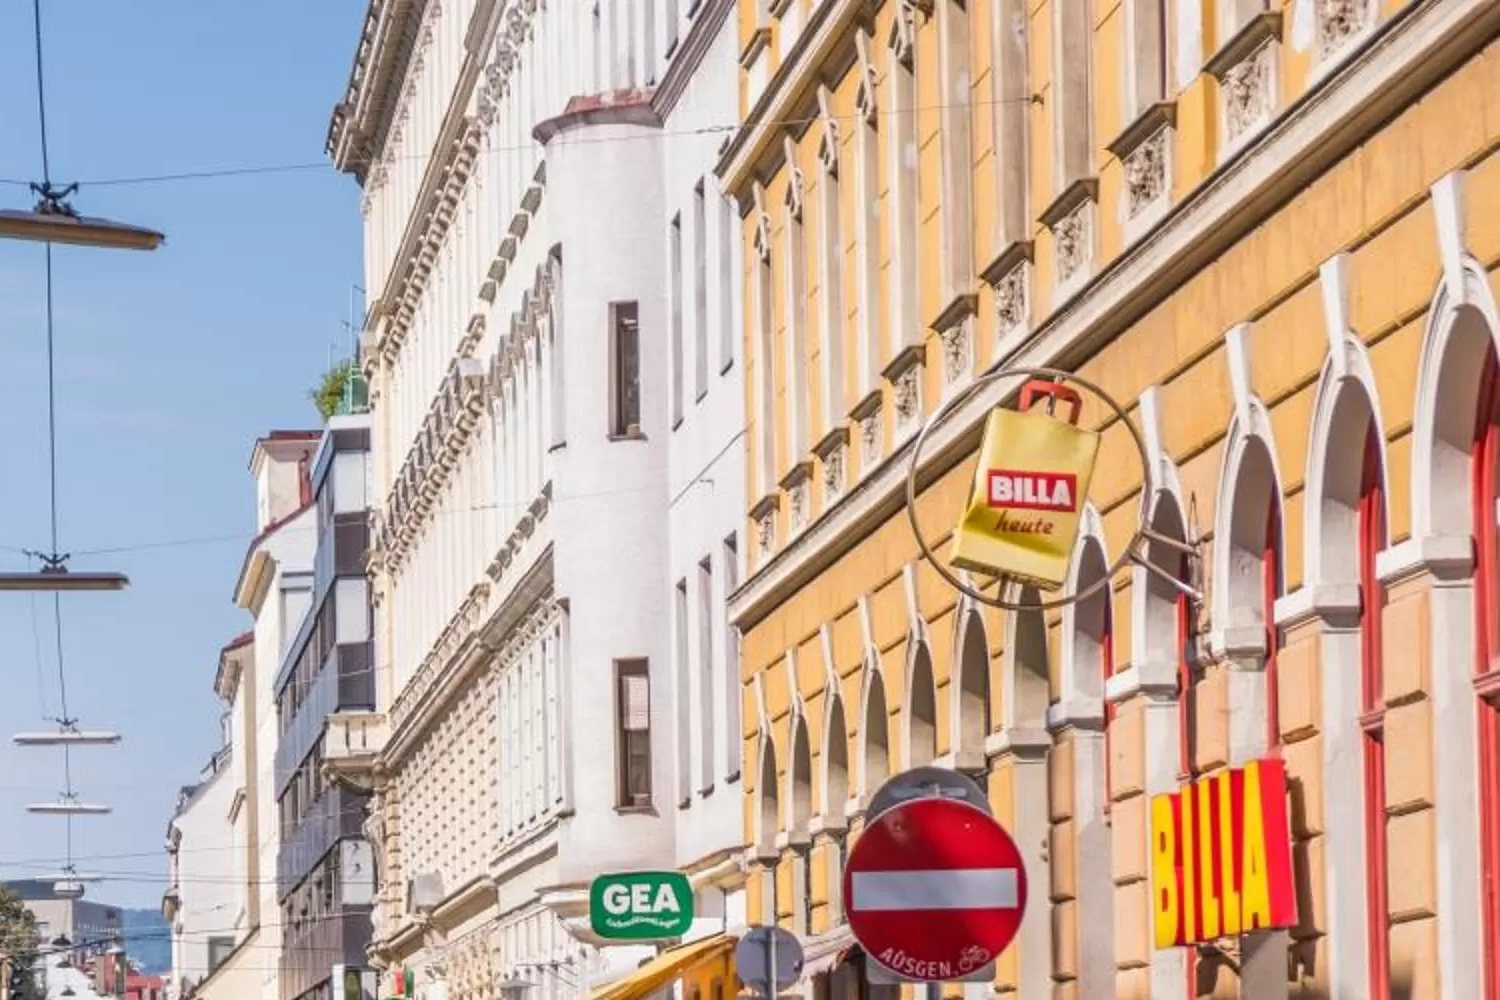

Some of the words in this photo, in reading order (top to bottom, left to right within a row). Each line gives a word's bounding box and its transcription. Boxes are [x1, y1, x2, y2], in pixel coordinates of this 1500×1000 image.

[991, 475, 1072, 506] BILLA
[994, 509, 1054, 535] heute
[1152, 759, 1271, 950] BILLA
[603, 883, 680, 914] GEA
